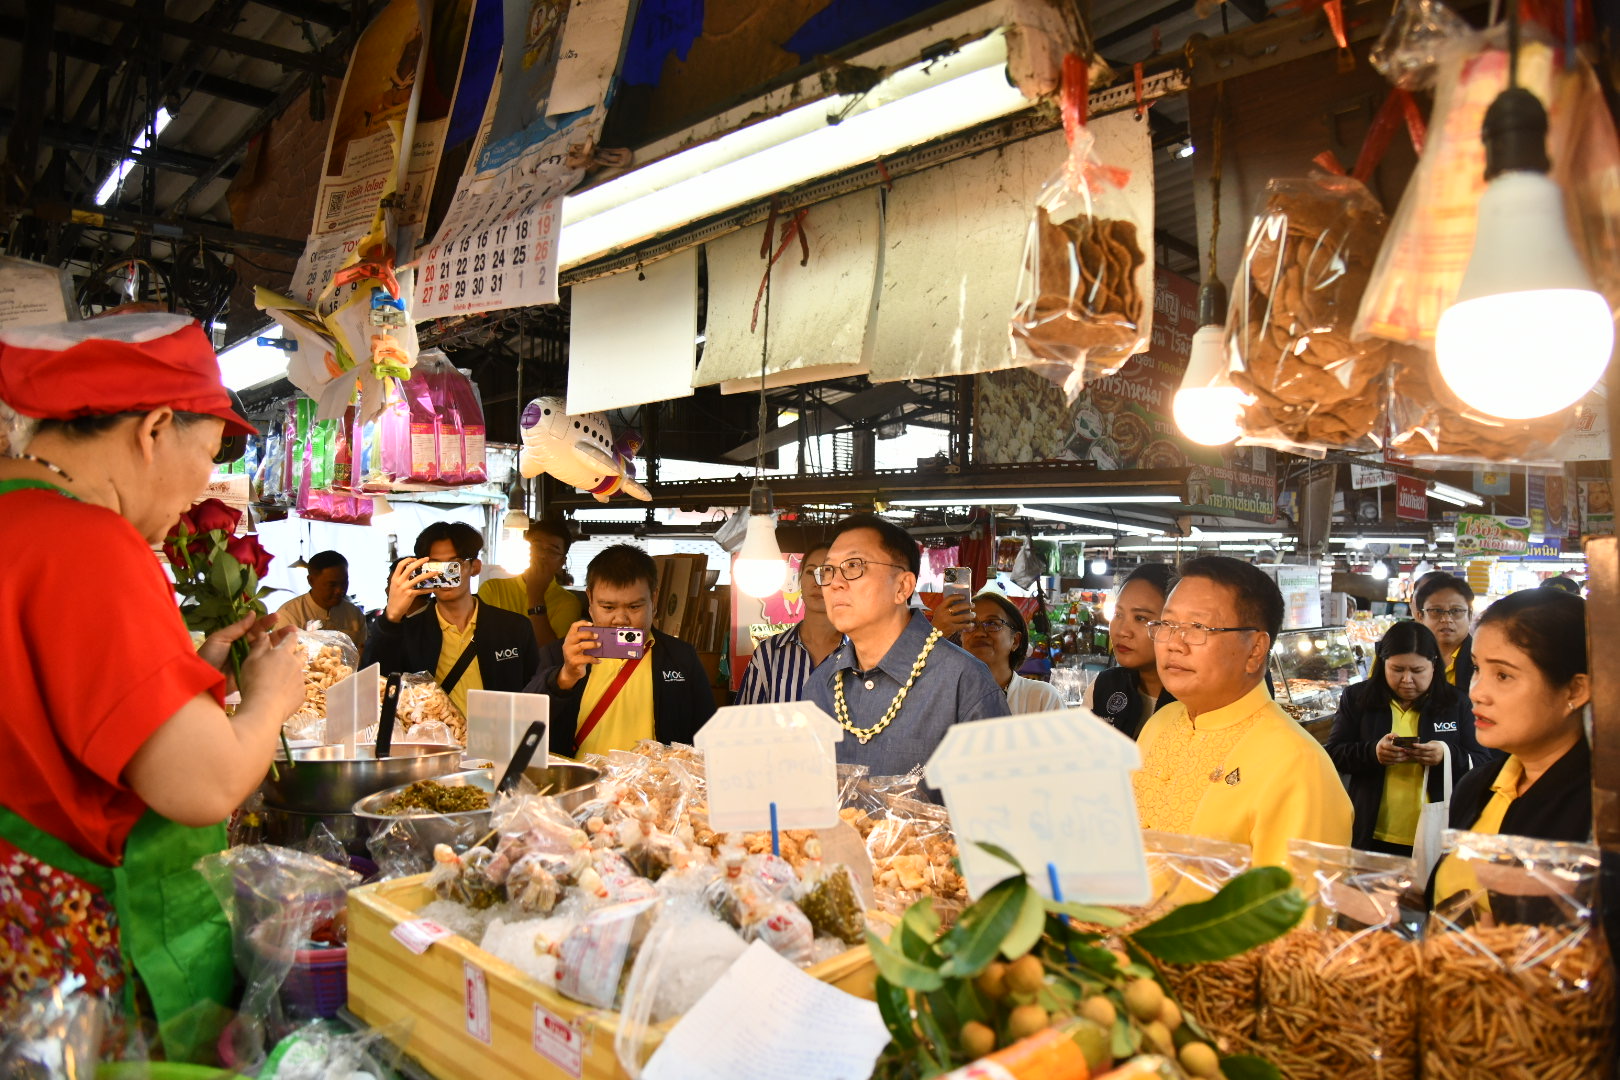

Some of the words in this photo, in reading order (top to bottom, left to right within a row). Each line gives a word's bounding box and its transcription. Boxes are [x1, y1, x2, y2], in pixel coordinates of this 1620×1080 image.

[502, 195, 513, 211] 2
[443, 240, 455, 257] 14
[459, 235, 472, 253] 15
[476, 229, 489, 249] 16
[495, 224, 508, 245] 17
[515, 220, 529, 240] 18
[537, 214, 551, 236] 19
[424, 264, 436, 283] 20
[440, 262, 450, 280] 21
[456, 257, 468, 276] 22
[473, 253, 486, 273] 23
[492, 249, 506, 269] 24
[512, 245, 527, 266] 25
[533, 240, 549, 262] 26
[306, 271, 316, 286] 29
[321, 267, 331, 282] 30
[422, 286, 434, 304] 27
[438, 283, 450, 302] 28
[454, 280, 467, 299] 29
[472, 277, 485, 296] 30
[490, 273, 503, 294] 31
[518, 270, 524, 289] 1
[537, 266, 547, 286] 2
[306, 288, 312, 302] 6
[334, 285, 341, 298] 8
[495, 647, 519, 660] MOC
[1433, 721, 1458, 732] MOC
